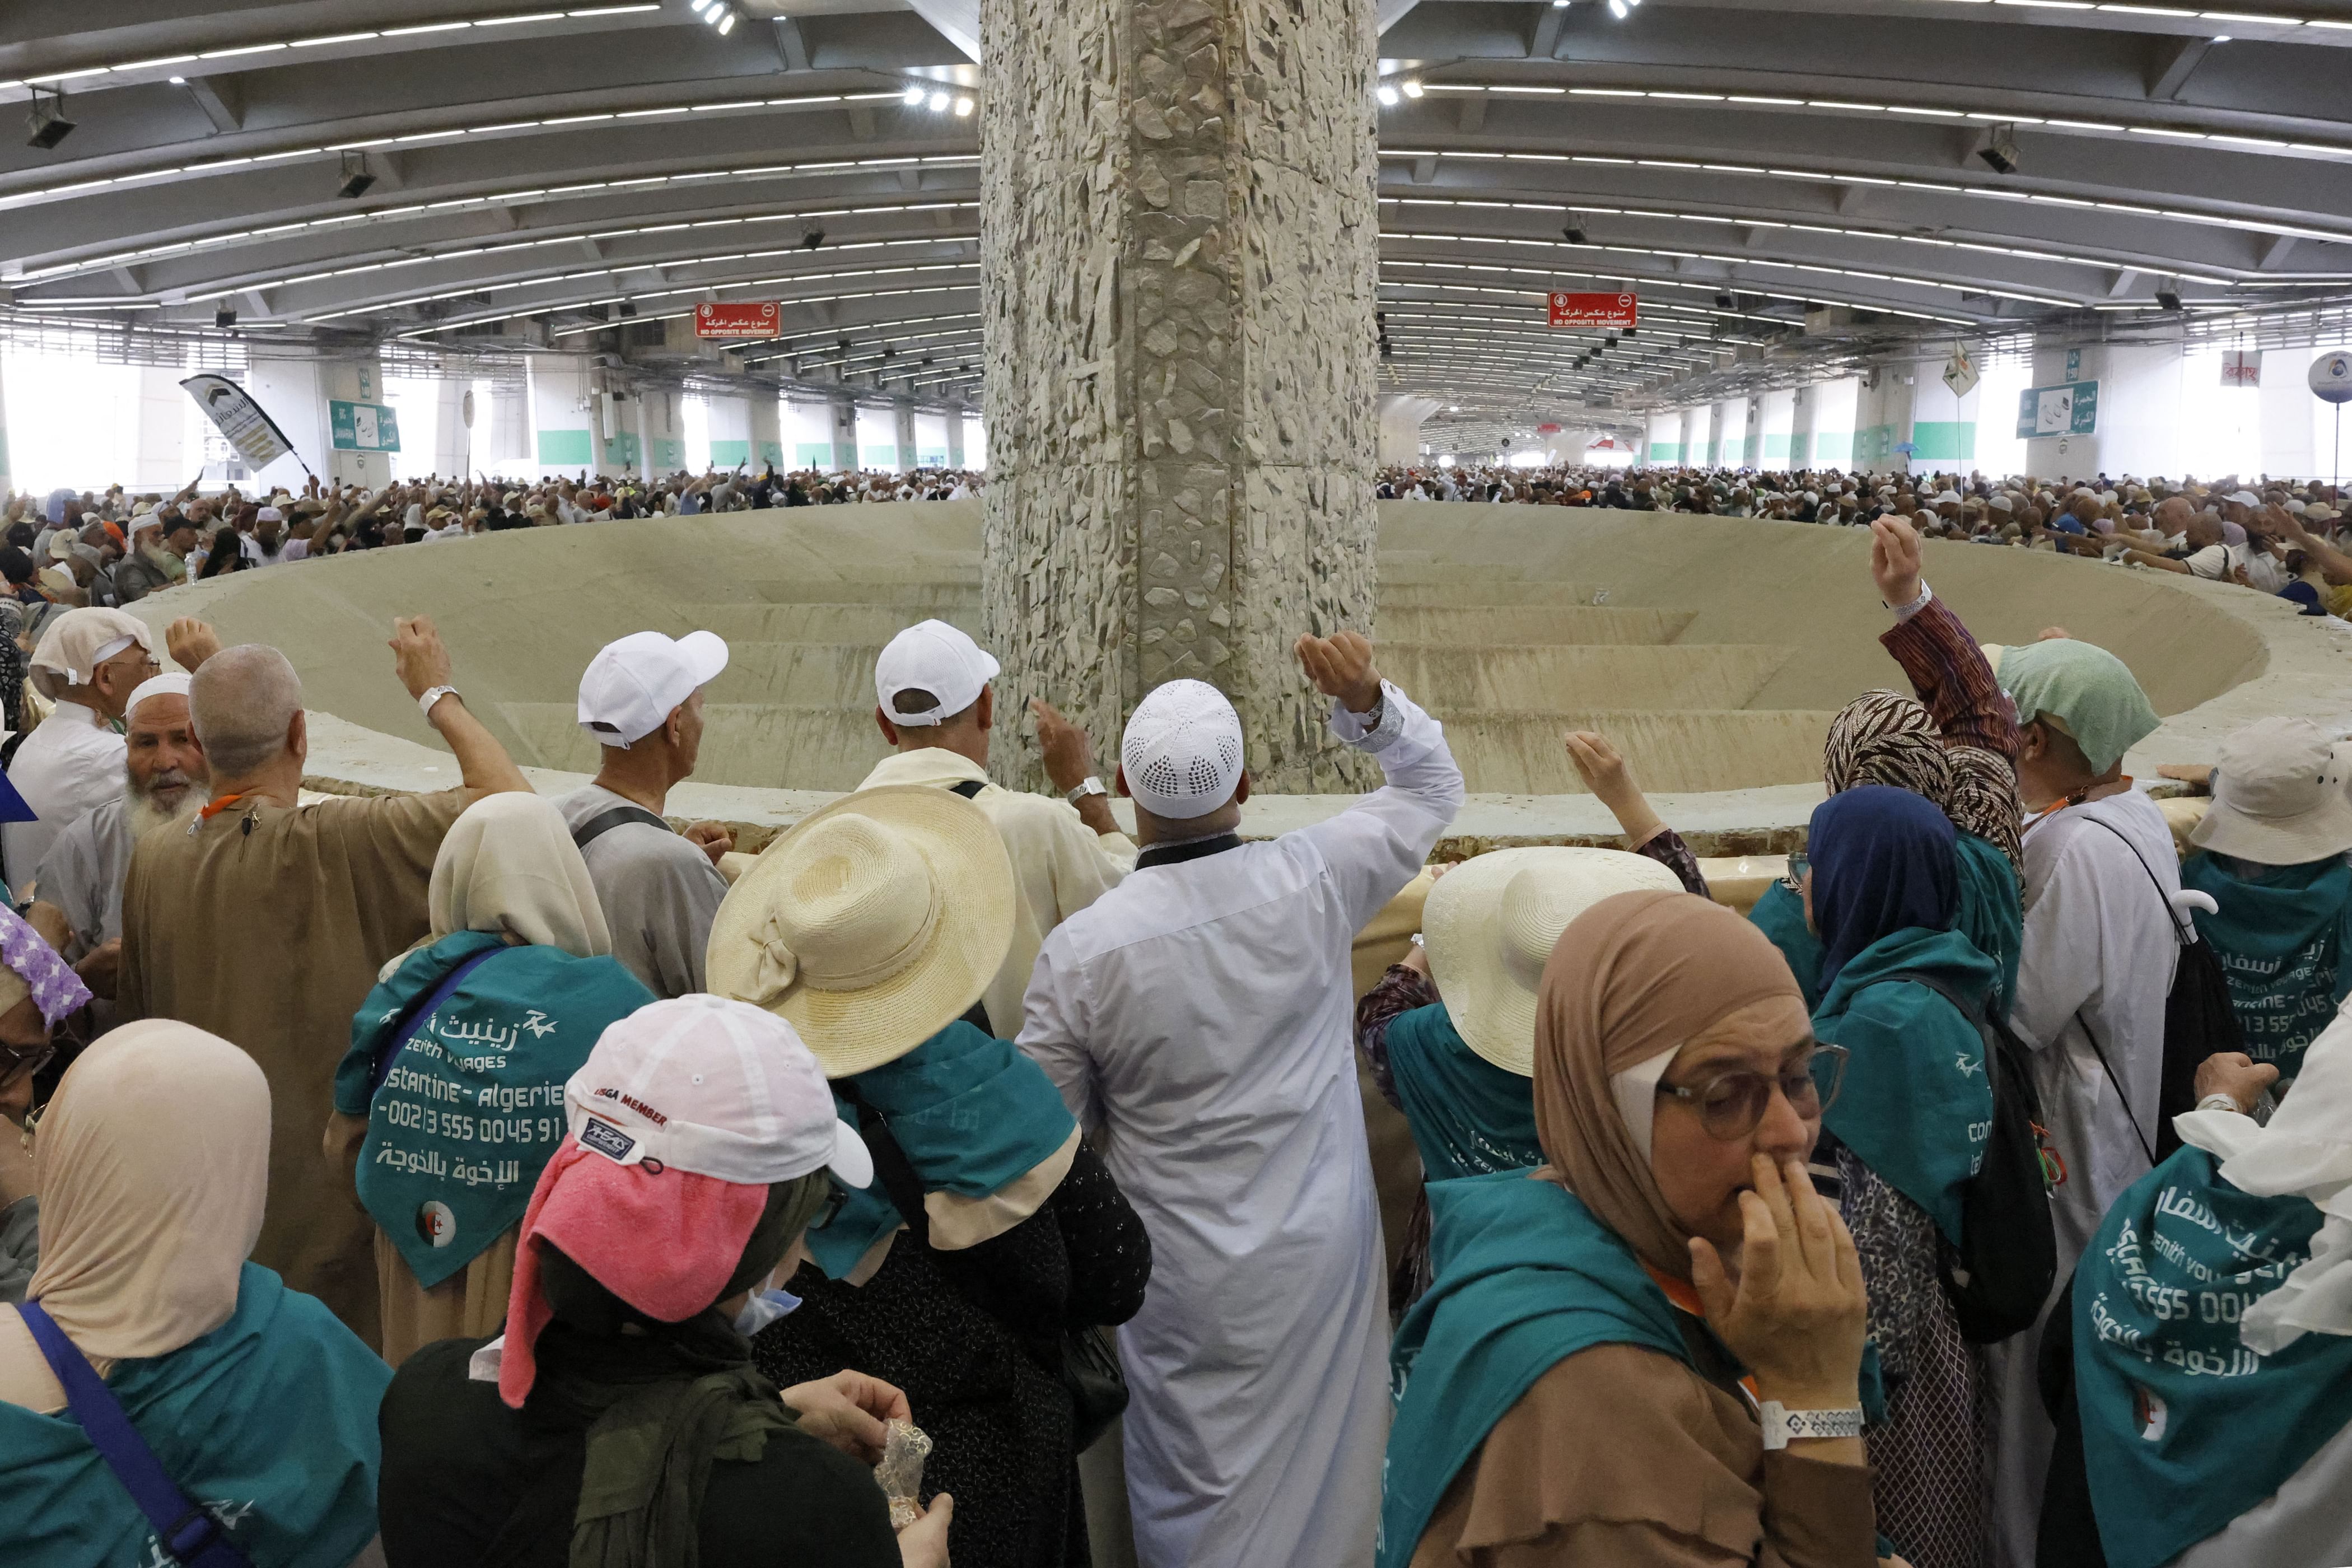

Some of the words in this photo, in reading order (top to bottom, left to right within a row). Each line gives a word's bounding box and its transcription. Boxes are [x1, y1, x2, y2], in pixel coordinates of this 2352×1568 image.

[1559, 308, 1582, 317] الحركة
[1584, 309, 1606, 318] عكس
[1607, 310, 1626, 319] ممنوع
[706, 318, 727, 327] الحركة
[728, 319, 749, 327] عكس
[751, 320, 770, 329] ممنوع
[594, 1088, 619, 1100] USGA
[620, 1094, 668, 1126] MEMBER
[441, 1113, 473, 1141] 555
[538, 1117, 559, 1142] 91
[452, 1157, 519, 1191] الإخوة
